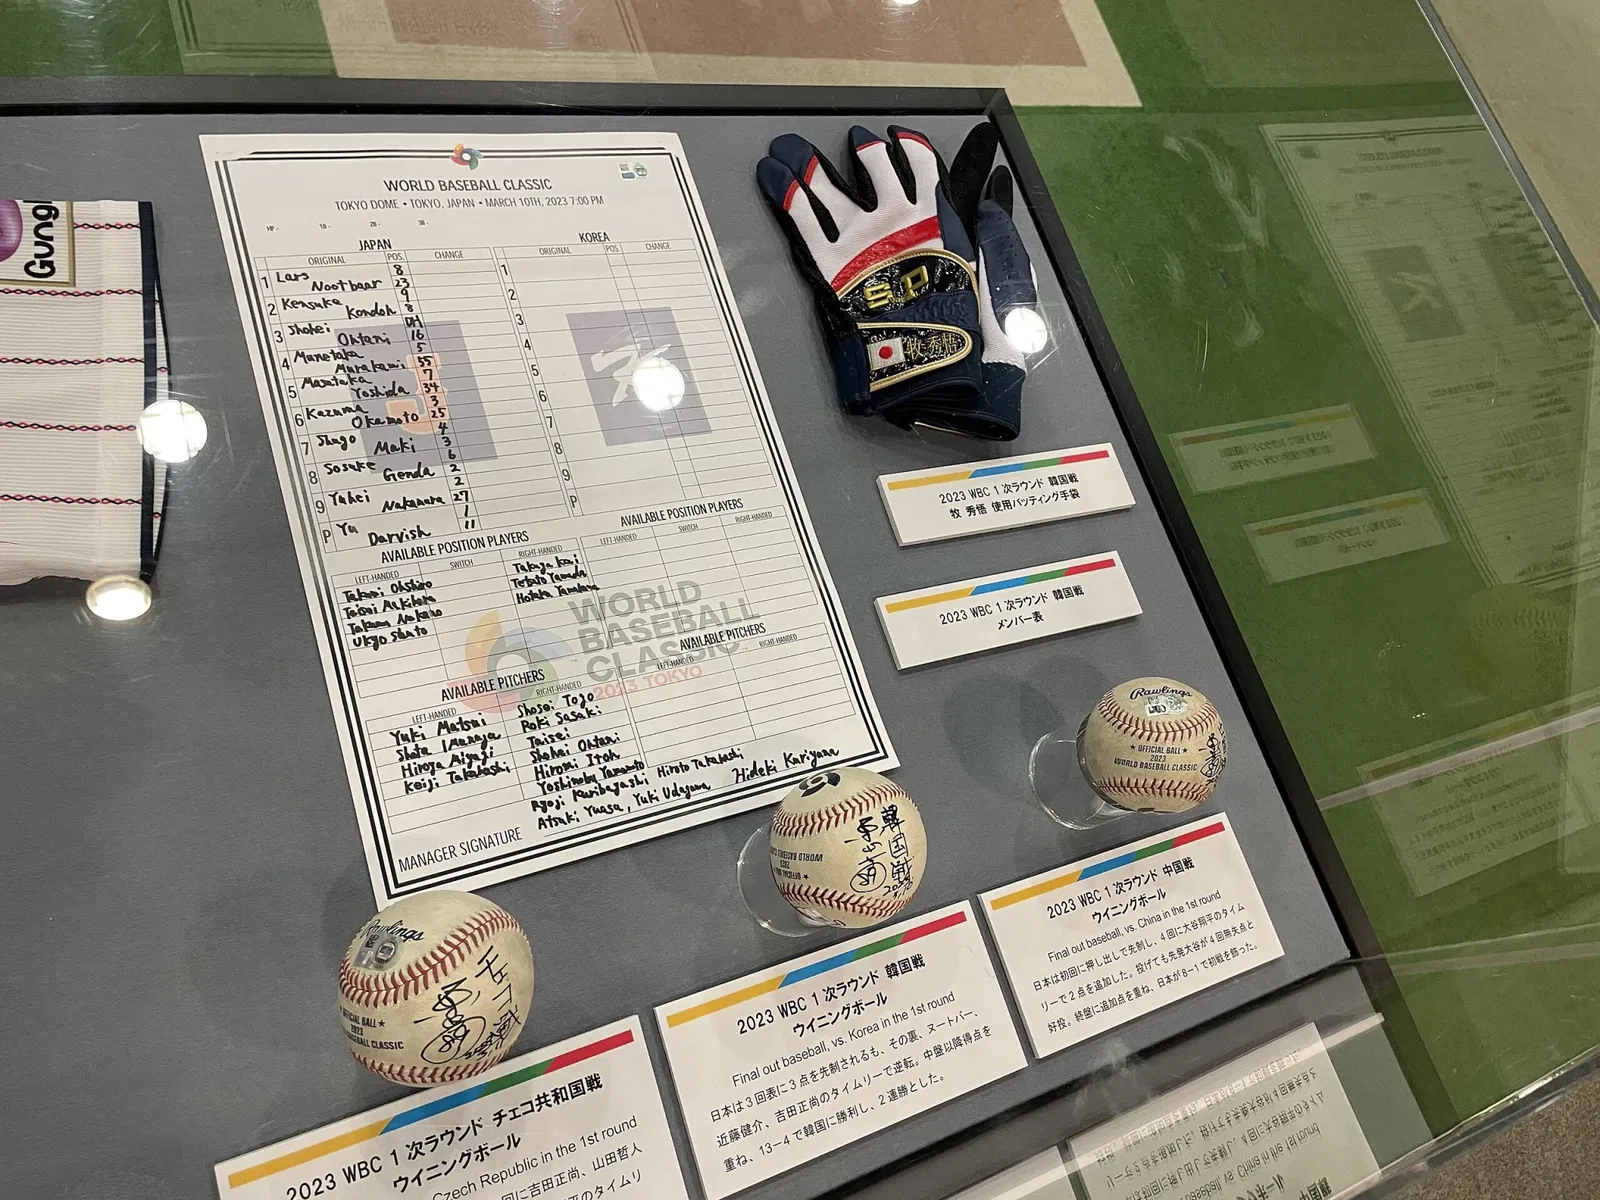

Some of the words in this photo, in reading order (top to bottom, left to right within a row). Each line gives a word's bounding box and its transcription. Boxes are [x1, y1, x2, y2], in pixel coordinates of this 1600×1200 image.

[384, 180, 435, 193] WORLD
[439, 179, 501, 192] BASEBALL
[503, 178, 553, 191] CLASSIC
[335, 200, 368, 212] TOKYO
[371, 199, 399, 210] DOME
[447, 197, 476, 208] JAPAN
[485, 196, 517, 208] MARCH
[547, 196, 567, 206] 2023
[569, 195, 588, 206] 7:00
[590, 195, 605, 205] PM
[359, 239, 392, 251] JAPAN
[578, 232, 610, 243] KOREA
[308, 255, 346, 266] ORIGINAL
[434, 250, 463, 259] CHANGE
[539, 247, 572, 255] ORIGINAL
[645, 242, 671, 251] CHANGE
[261, 276, 269, 289] 1
[267, 303, 277, 316] 2
[274, 330, 283, 343] 3
[282, 358, 290, 371] 4
[288, 386, 297, 399] 5
[295, 414, 304, 427] 6
[301, 443, 311, 456] 7
[373, 438, 417, 456] Maki
[308, 471, 318, 485] 8
[383, 462, 435, 483] Genda
[939, 492, 966, 505] 2023
[968, 486, 991, 498] WBC
[1048, 473, 1079, 486] 韓国戦
[316, 500, 326, 514] 9
[621, 508, 666, 527] AVAILABLE
[667, 503, 707, 520] POSITION
[709, 498, 744, 514] PLAYERS
[949, 508, 961, 519] 牧
[966, 503, 988, 517] 秀悟
[992, 488, 1081, 513] 使用バッティング手袋
[323, 529, 331, 543] P
[368, 525, 432, 546] Darvish
[600, 533, 637, 545] LEFT-HANDED
[678, 523, 699, 533] SWITCH
[735, 511, 772, 523] RIGHT-HANDED
[381, 545, 435, 564] AVAILABLE
[438, 537, 485, 555] POSITION
[487, 530, 530, 548] PLAYERS
[354, 570, 400, 585] LEFT-HANDED
[450, 558, 474, 570] SWITCH
[518, 544, 563, 559] RIGHT-HANDED
[567, 580, 701, 626] WORLD
[939, 611, 967, 625] 2023
[970, 605, 993, 618] WBC
[1052, 585, 1084, 601] 韓国戦
[578, 597, 760, 654] BASEBALL
[997, 611, 1045, 630] メンバー表
[680, 631, 725, 651] AVAILABLE
[726, 622, 766, 642] PITCHERS
[657, 655, 694, 670] LEFT-HANDED
[758, 633, 797, 647] RIGHT-HANDED
[441, 678, 497, 701] AVAILABLE
[498, 668, 545, 690] PITCHERS
[593, 679, 638, 701] 2023
[643, 665, 703, 688] TOKYO
[1130, 685, 1193, 700] Rawlings
[412, 707, 457, 724] LEFT-HANDED
[536, 680, 582, 697] RIGHT-HANDED
[521, 716, 550, 733] Roki
[557, 705, 602, 725] Sasaki
[390, 726, 426, 746] Yuki
[1138, 744, 1164, 754] OFFICIAL
[1166, 746, 1181, 755] BALL
[1150, 754, 1166, 762] 2023
[1114, 757, 1138, 768] WORLD
[1139, 762, 1170, 771] BASEBALL
[633, 789, 660, 807] Yuki
[398, 846, 458, 872] MANAGER
[459, 827, 523, 855] SIGNATURE
[1047, 900, 1076, 919] 2023
[1079, 891, 1102, 908] WBC
[1162, 856, 1195, 877] 中国戦
[1092, 888, 1167, 924] ウイニングボール
[1048, 946, 1070, 963] Final
[1071, 941, 1086, 955] out
[1087, 927, 1123, 951] baseball,
[1125, 922, 1137, 934] vs.
[1137, 911, 1162, 930] China
[1162, 908, 1170, 919] in
[1170, 902, 1185, 917] the
[1185, 896, 1199, 911] 1st
[1198, 889, 1221, 908] round
[737, 1010, 774, 1035] 2023
[778, 997, 808, 1020] WBC
[884, 953, 926, 981] 韓国戦
[362, 1018, 376, 1028] BALL
[792, 992, 888, 1038] ウイニングボール
[351, 1025, 363, 1036] 2023
[733, 1066, 761, 1088] Final
[762, 1060, 780, 1077] out
[782, 1041, 830, 1070] baseball,
[831, 1035, 847, 1049] vs.
[848, 1019, 880, 1042] Korea
[881, 1016, 891, 1029] in
[892, 1008, 909, 1026] the
[910, 1002, 926, 1019] 1st
[926, 992, 955, 1015] round
[372, 1040, 404, 1050] CLASSIC
[286, 1173, 337, 1200] 2023
[342, 1156, 383, 1184] WBC
[492, 1073, 604, 1127] チェコ共和国戦
[393, 1133, 521, 1193] ウイニングボール
[432, 1180, 477, 1200] Czech
[480, 1158, 538, 1189] Republic
[541, 1149, 553, 1164] in
[555, 1141, 577, 1159] the
[580, 1131, 600, 1148] 1st
[601, 1115, 638, 1140] round
